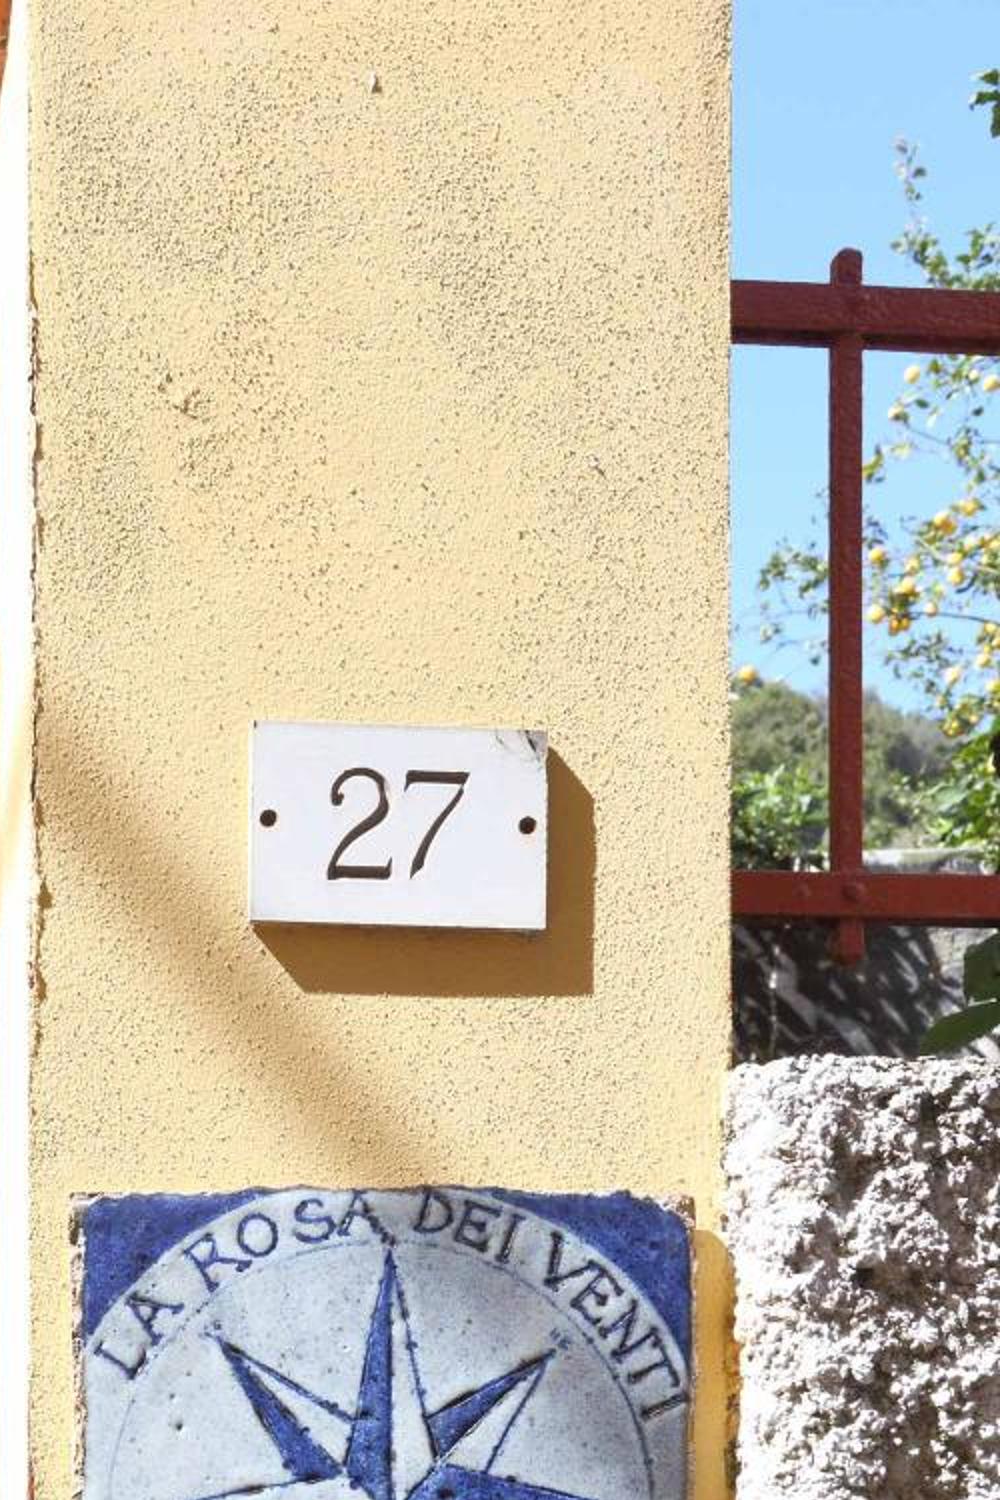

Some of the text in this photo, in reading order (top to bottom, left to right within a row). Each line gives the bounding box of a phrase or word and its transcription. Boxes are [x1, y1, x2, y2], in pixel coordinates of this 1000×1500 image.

[327, 767, 470, 880] 27
[93, 1191, 690, 1423] LA ROSA DEI VENTI
